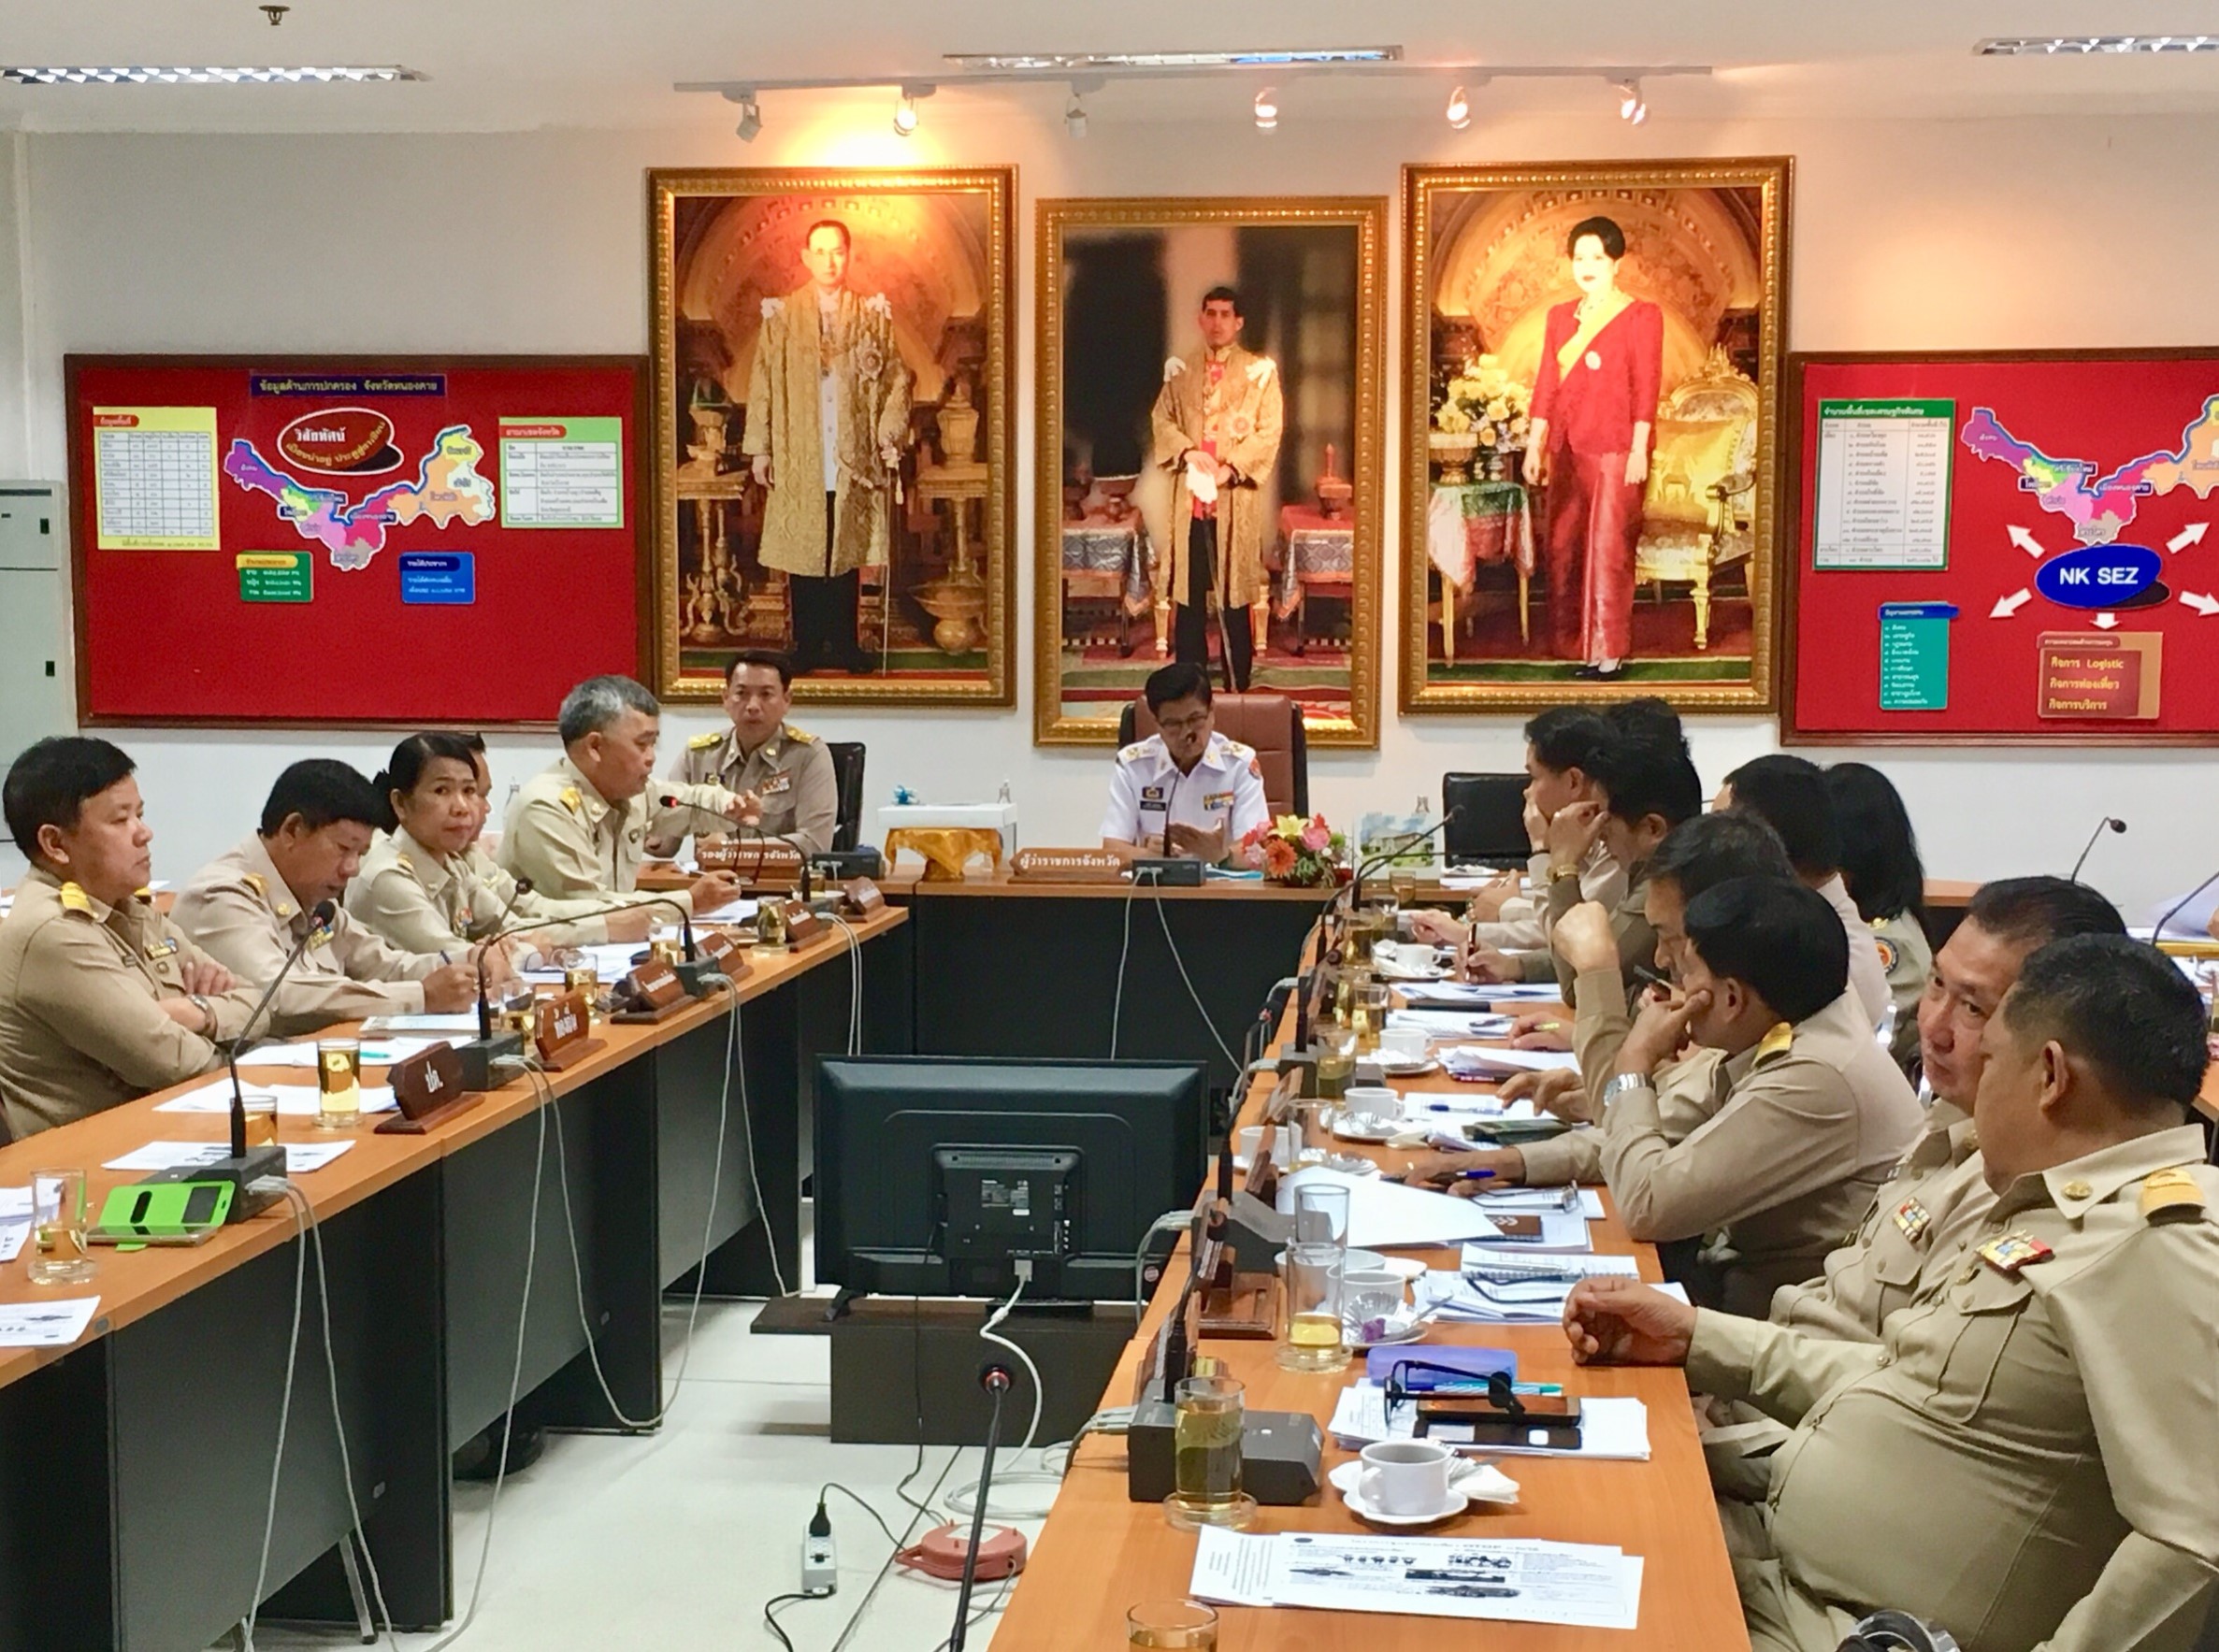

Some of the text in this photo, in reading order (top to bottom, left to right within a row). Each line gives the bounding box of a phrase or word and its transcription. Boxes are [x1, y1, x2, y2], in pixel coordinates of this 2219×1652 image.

[364, 380, 438, 392] จังหวัดหนองคาย
[295, 426, 346, 442] วิสัยทัศน์
[2060, 567, 2140, 585] NK SEZ
[2051, 656, 2125, 670] กิจการ Logistic
[2049, 676, 2120, 690] กิจการท่องเที่ยว
[2048, 697, 2108, 711] กิจการบริการ
[1019, 853, 1121, 869] ผู้ว่าราชการจังหวัด
